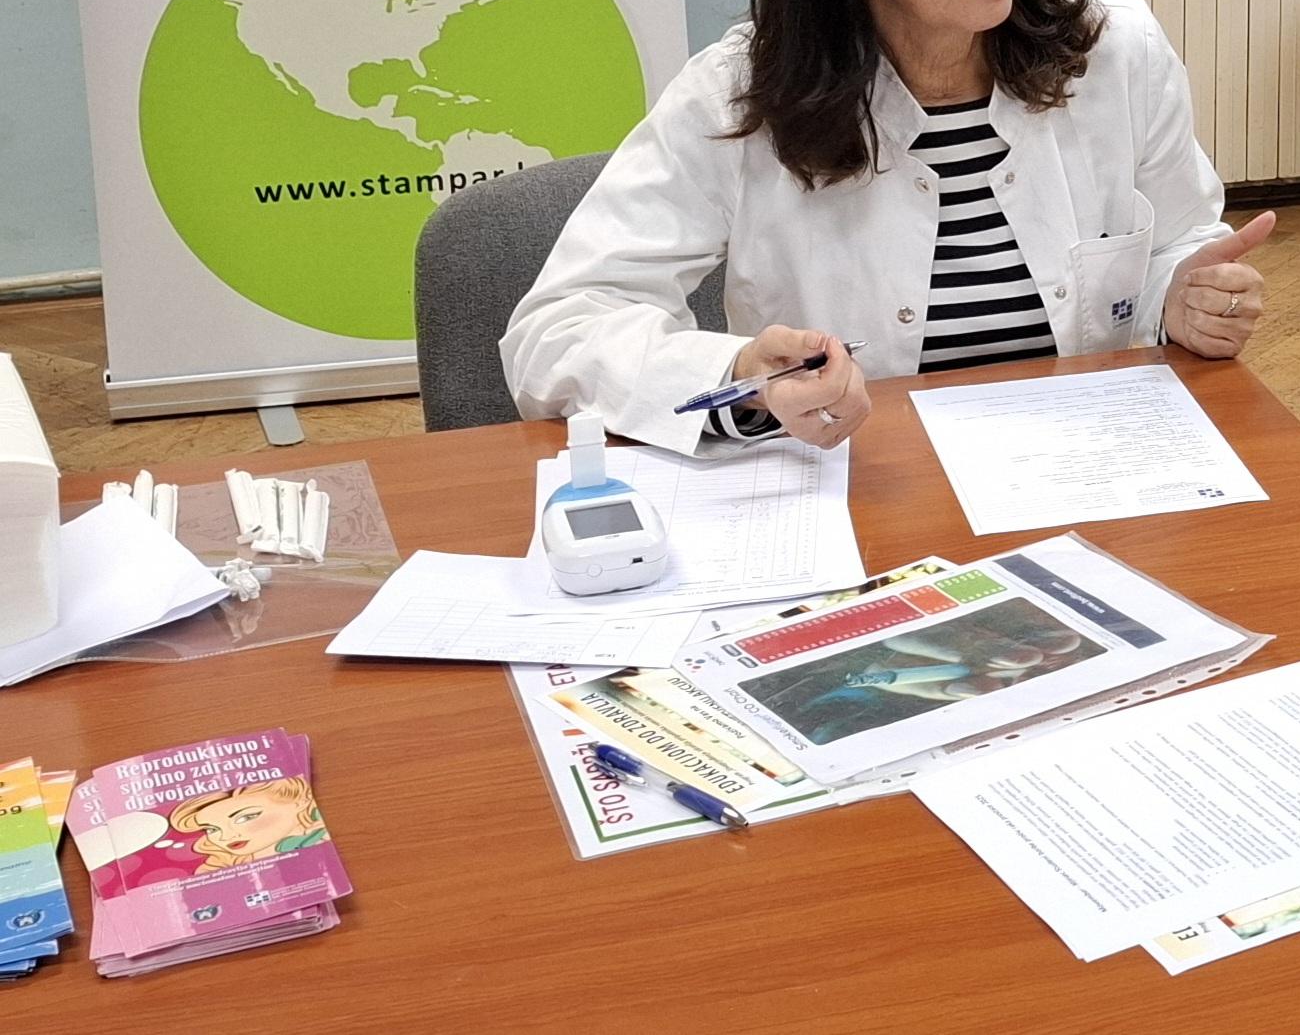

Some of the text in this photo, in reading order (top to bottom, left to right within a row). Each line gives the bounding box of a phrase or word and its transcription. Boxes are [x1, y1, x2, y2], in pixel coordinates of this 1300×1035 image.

[580, 692, 648, 733] ZDRAVLJA
[115, 735, 271, 780] Reproduktivno i
[637, 728, 666, 746] DO
[120, 770, 186, 796] spolno
[189, 752, 268, 779] zdravlje
[656, 740, 745, 794] EDUKACIJOM
[124, 778, 220, 811] djevojaka
[223, 773, 232, 788] i
[598, 793, 634, 826] ŠTO
